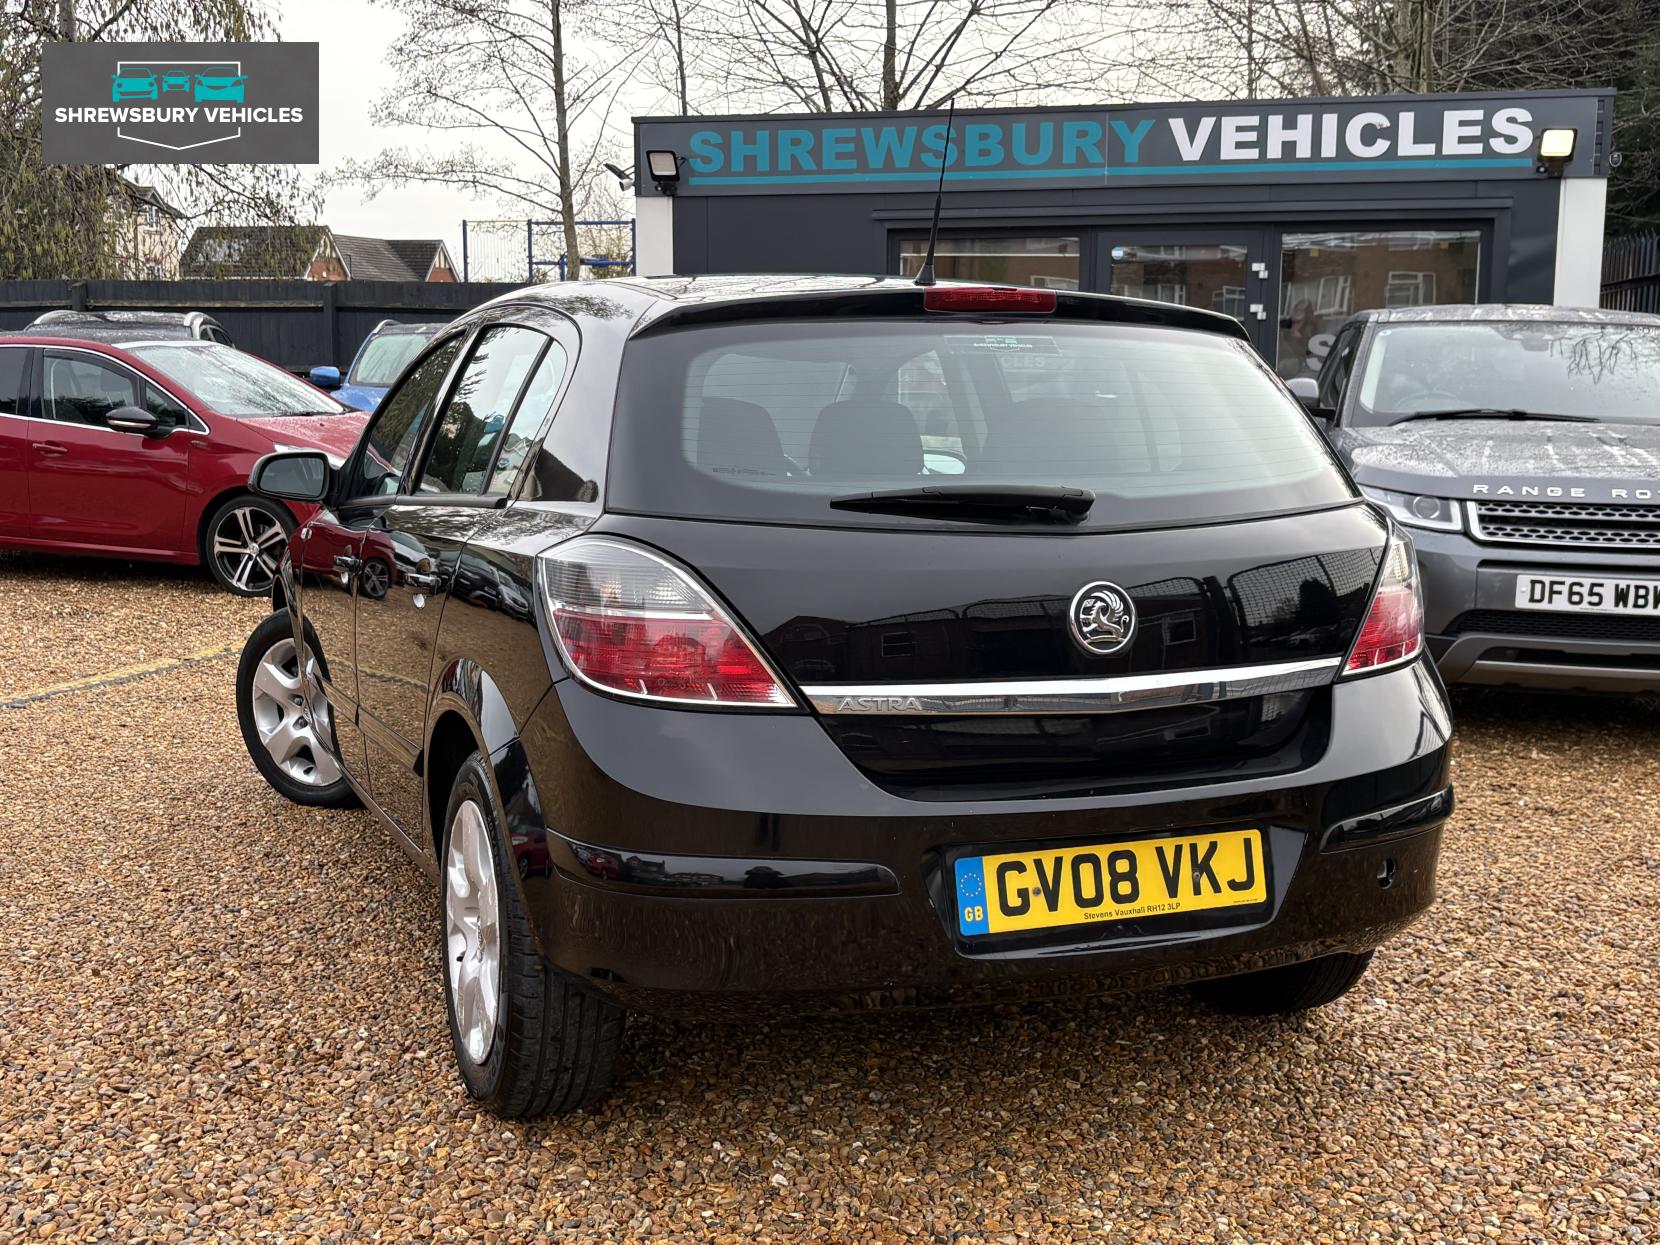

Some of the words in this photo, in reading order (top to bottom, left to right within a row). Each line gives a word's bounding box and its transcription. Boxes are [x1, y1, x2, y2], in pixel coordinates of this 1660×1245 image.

[688, 119, 1156, 173] SHREWSBURY
[1168, 107, 1534, 162] VEHICLES
[1473, 484, 1585, 498] RANGE
[1611, 489, 1660, 499] RO
[1528, 579, 1604, 607] DF65
[838, 697, 923, 712] ASTRA
[996, 849, 1140, 917] GV08
[1155, 837, 1256, 899] VKJ
[964, 905, 984, 922] GB
[1084, 911, 1113, 920] Stevens
[1115, 906, 1146, 917] Vauxhall
[1147, 903, 1166, 913] RH12
[1167, 902, 1181, 911] 3LP
